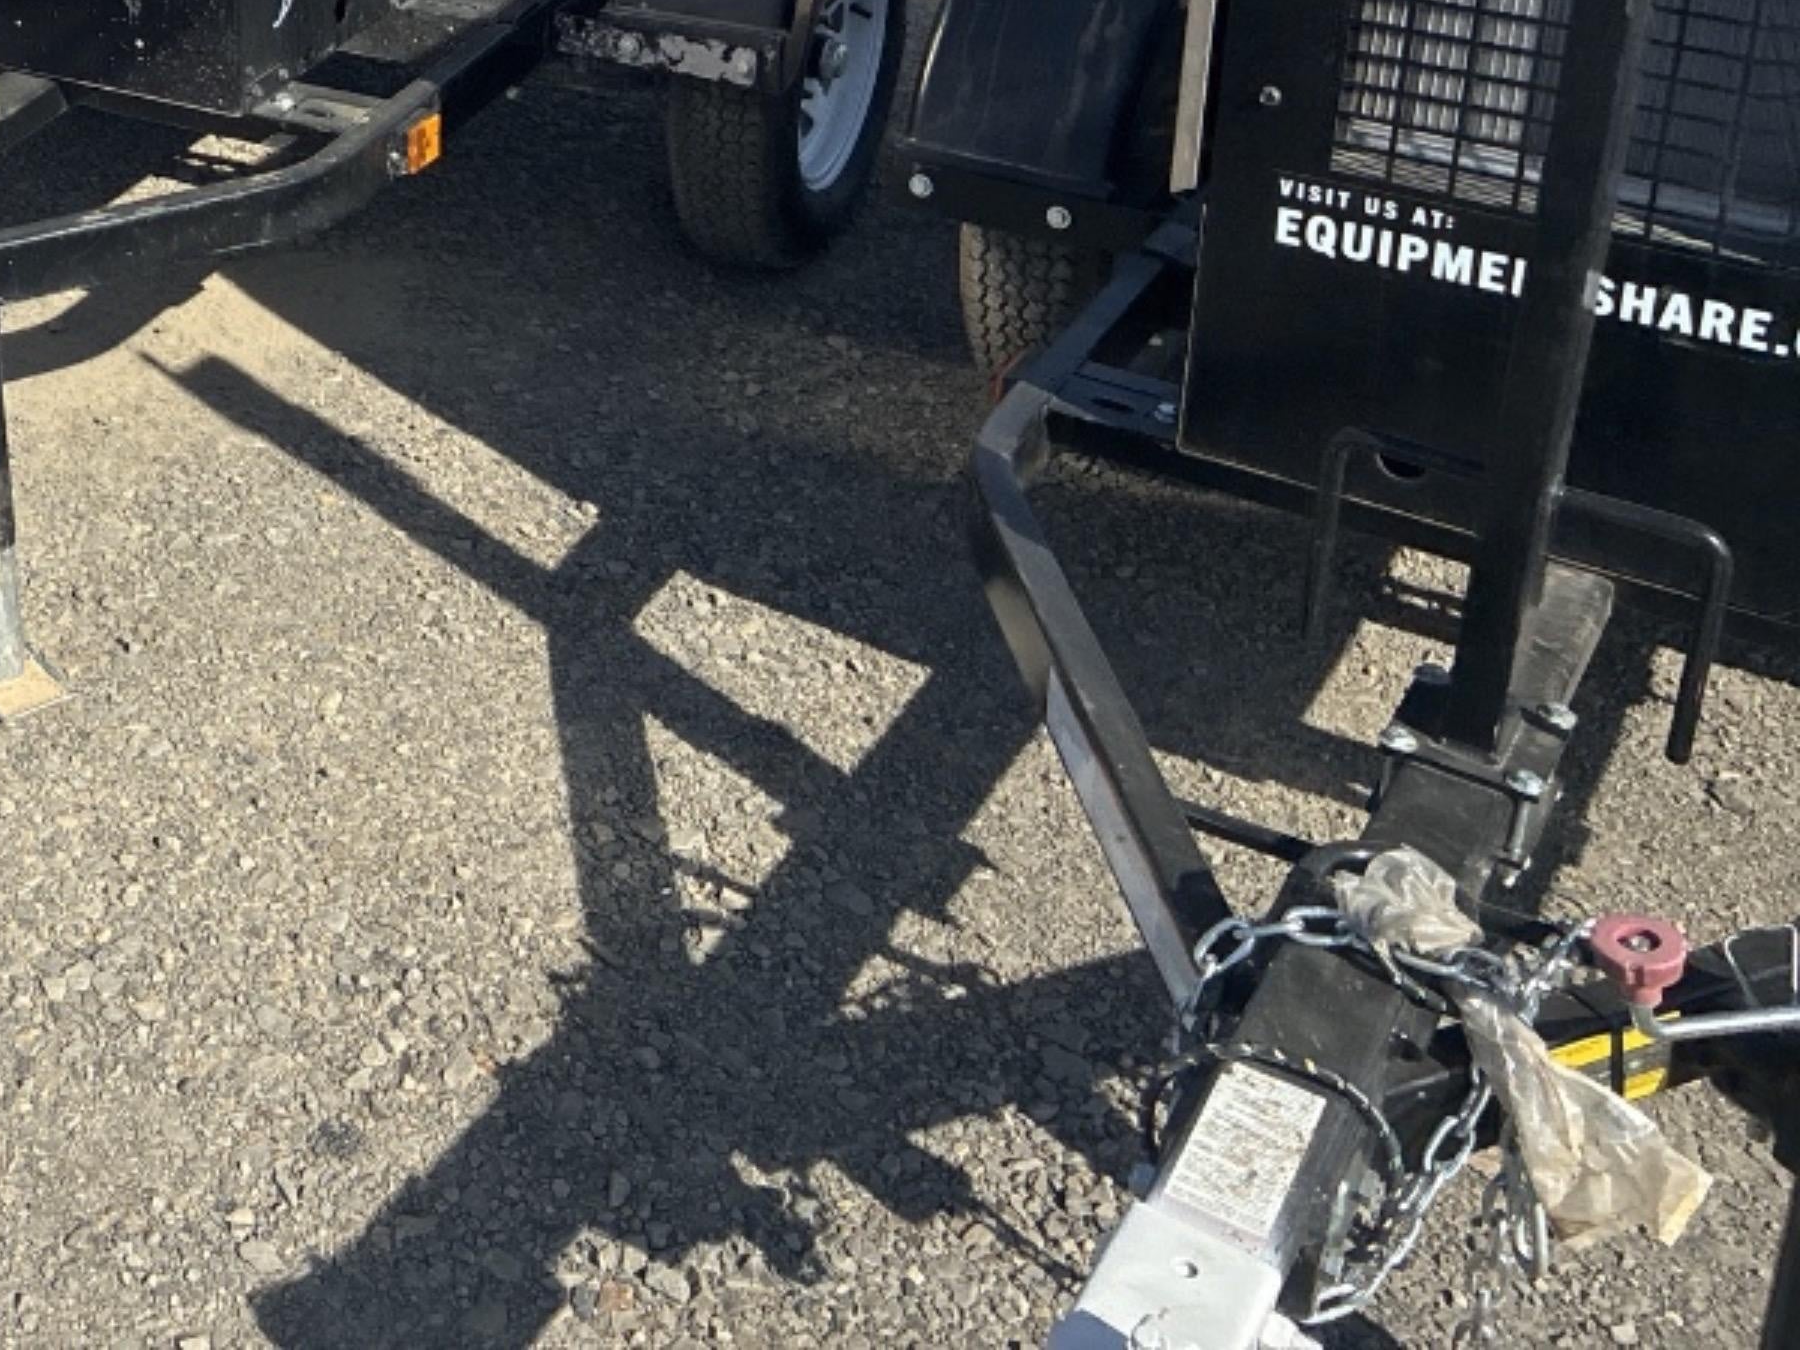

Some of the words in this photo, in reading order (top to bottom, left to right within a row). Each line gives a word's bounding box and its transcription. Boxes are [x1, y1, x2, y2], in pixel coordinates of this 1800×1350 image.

[1279, 176, 1351, 211] VISIT
[1364, 195, 1400, 221] US
[1410, 205, 1456, 230] AT:
